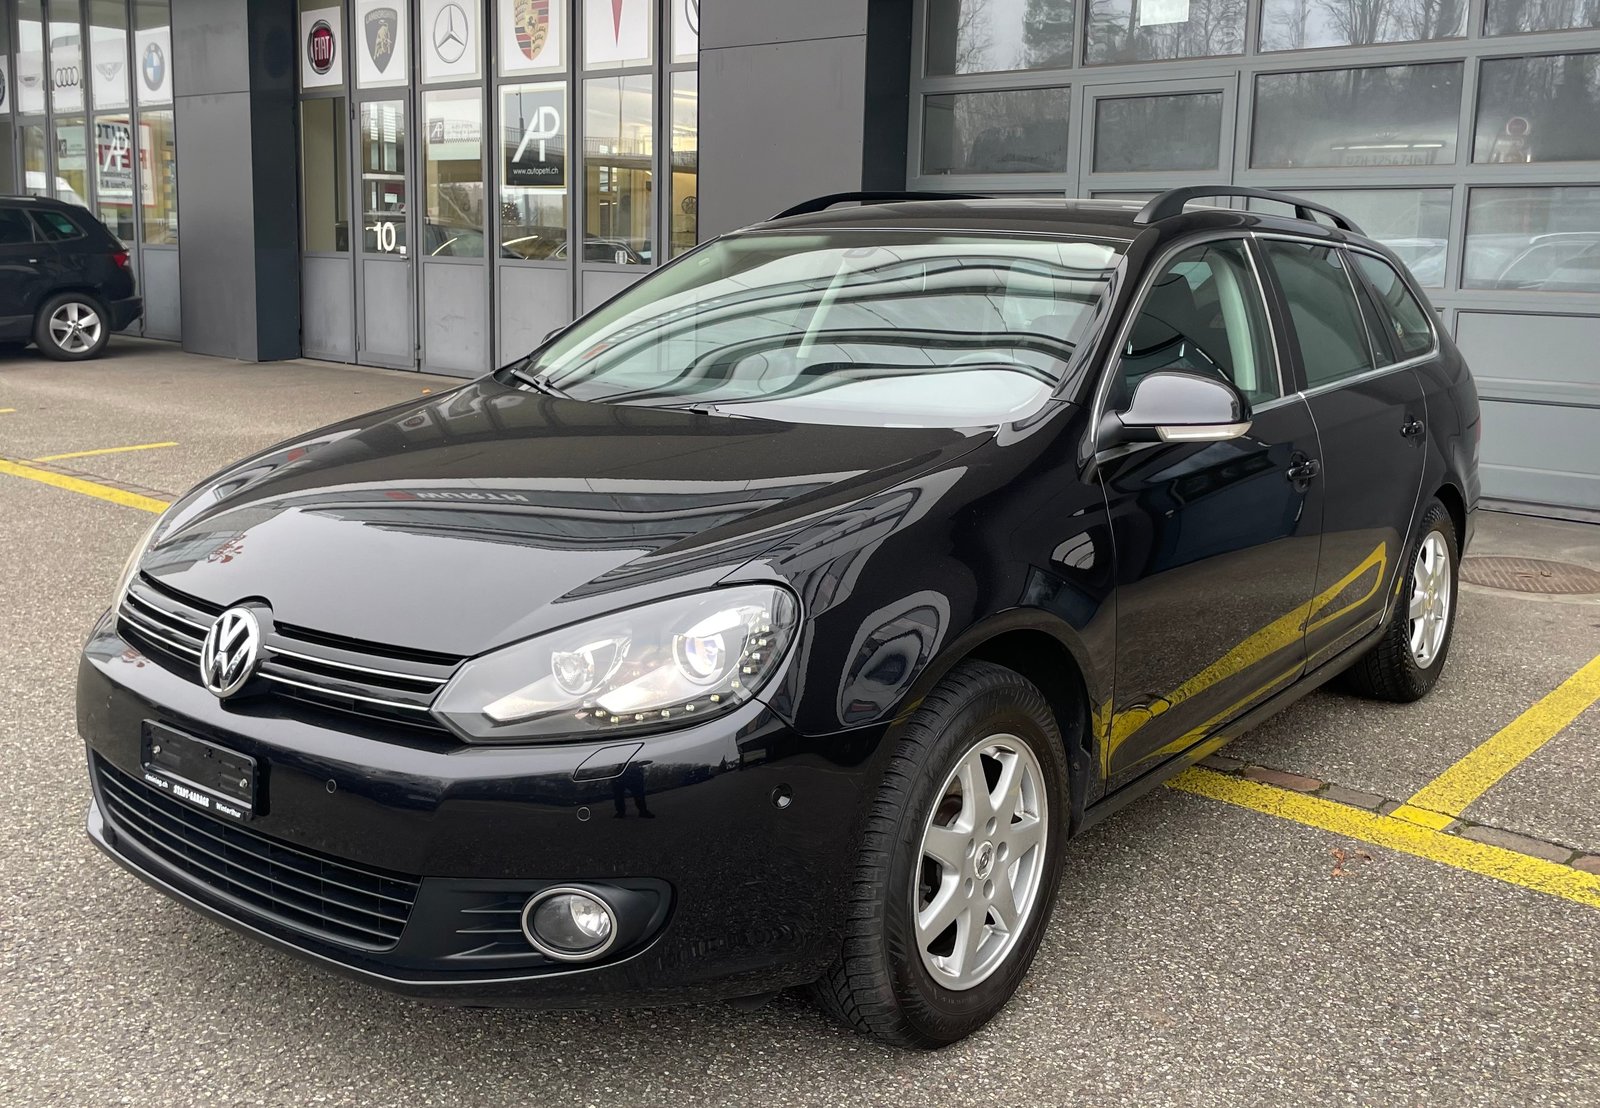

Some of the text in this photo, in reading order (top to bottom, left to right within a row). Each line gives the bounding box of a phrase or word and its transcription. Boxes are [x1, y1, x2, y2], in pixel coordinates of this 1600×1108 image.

[314, 35, 330, 61] FIAT
[512, 166, 559, 176] www.autopetri.ch
[373, 221, 397, 252] 10
[216, 802, 242, 819] Winterthur
